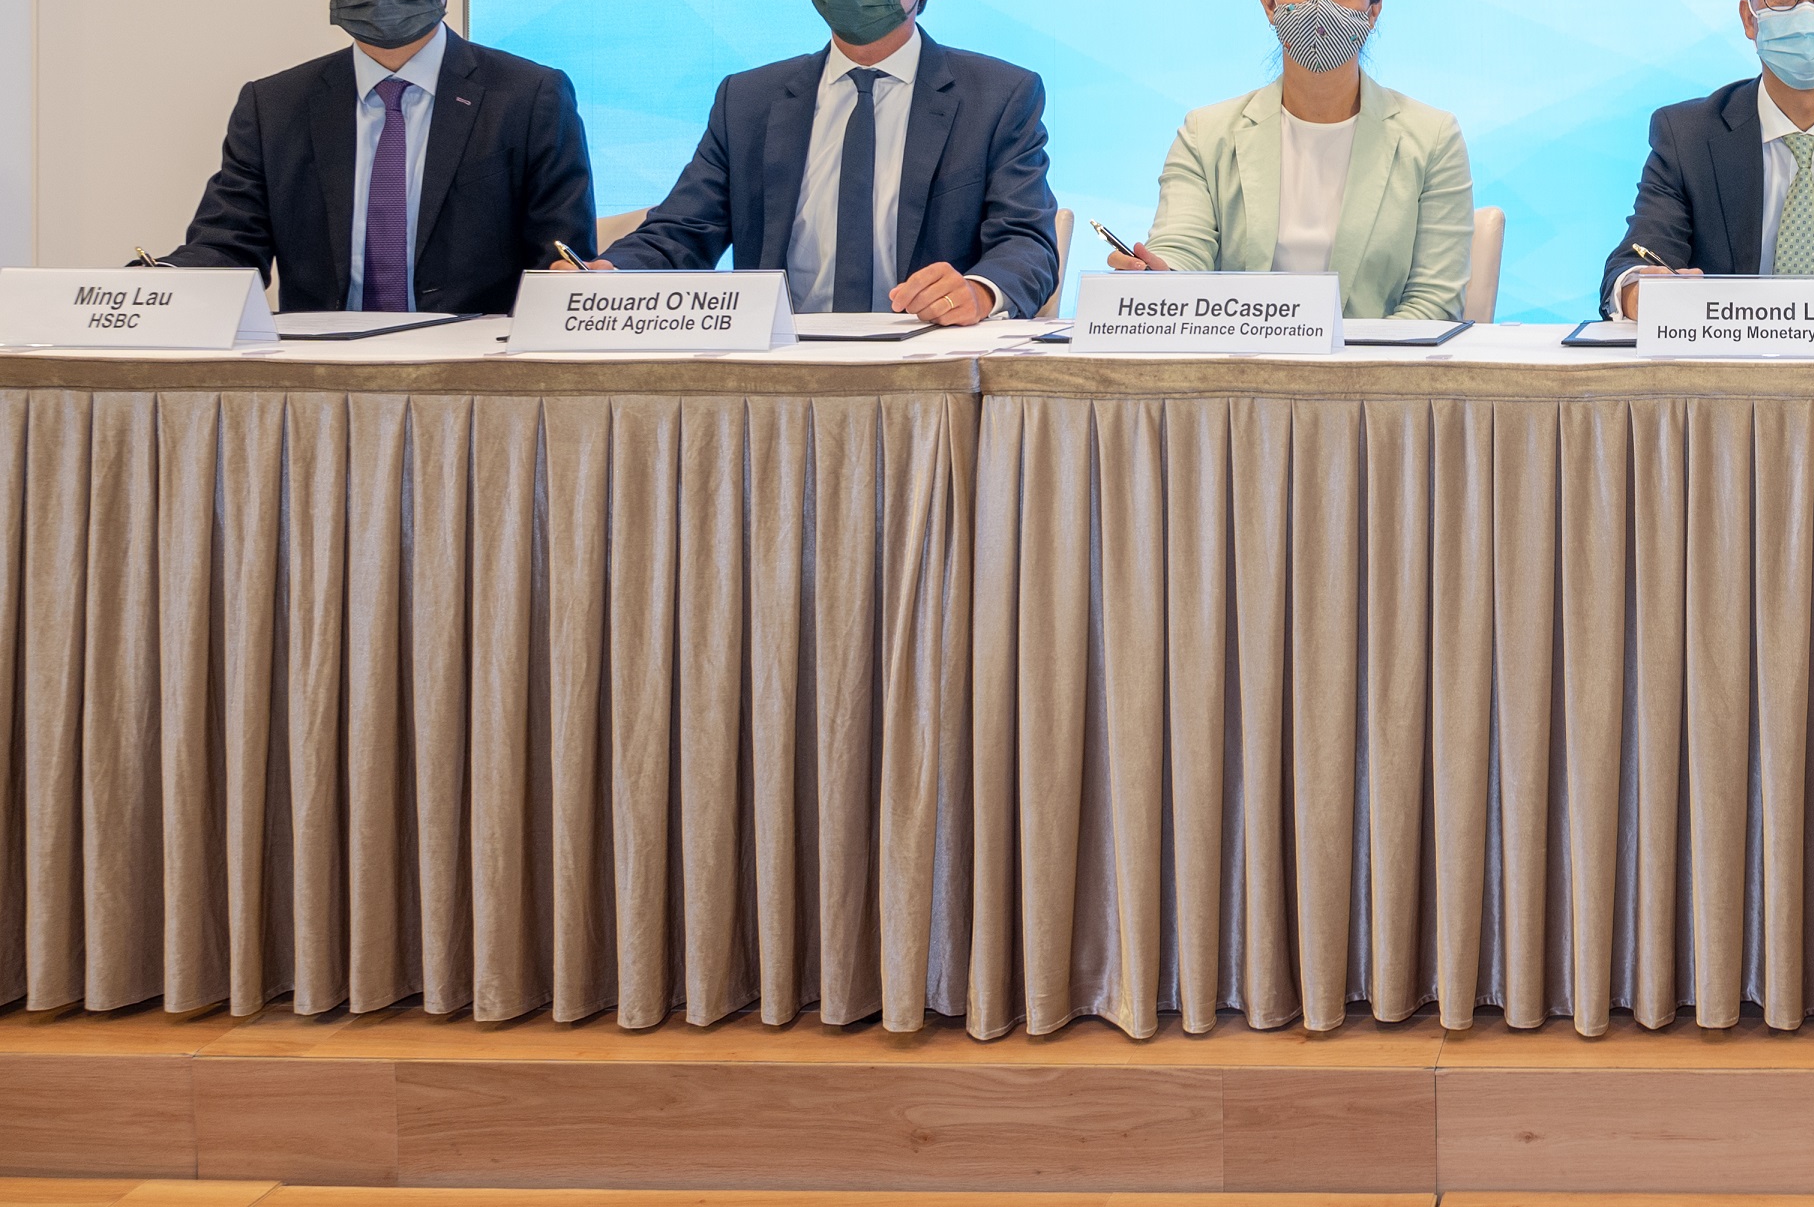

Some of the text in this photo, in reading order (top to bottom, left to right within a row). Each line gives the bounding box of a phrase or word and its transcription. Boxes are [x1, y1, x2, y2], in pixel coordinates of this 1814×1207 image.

[74, 287, 172, 310] Ming Lau
[567, 292, 661, 311] Edouard
[1118, 298, 1300, 322] Hester DeCasper
[1707, 302, 1796, 320] Edmond
[89, 313, 140, 328] HSBC
[565, 315, 732, 334] Crédit Agricole CIB
[1089, 322, 1323, 338] International Finance Corporation
[1658, 326, 1696, 341] Hong
[1702, 326, 1741, 342] Kong
